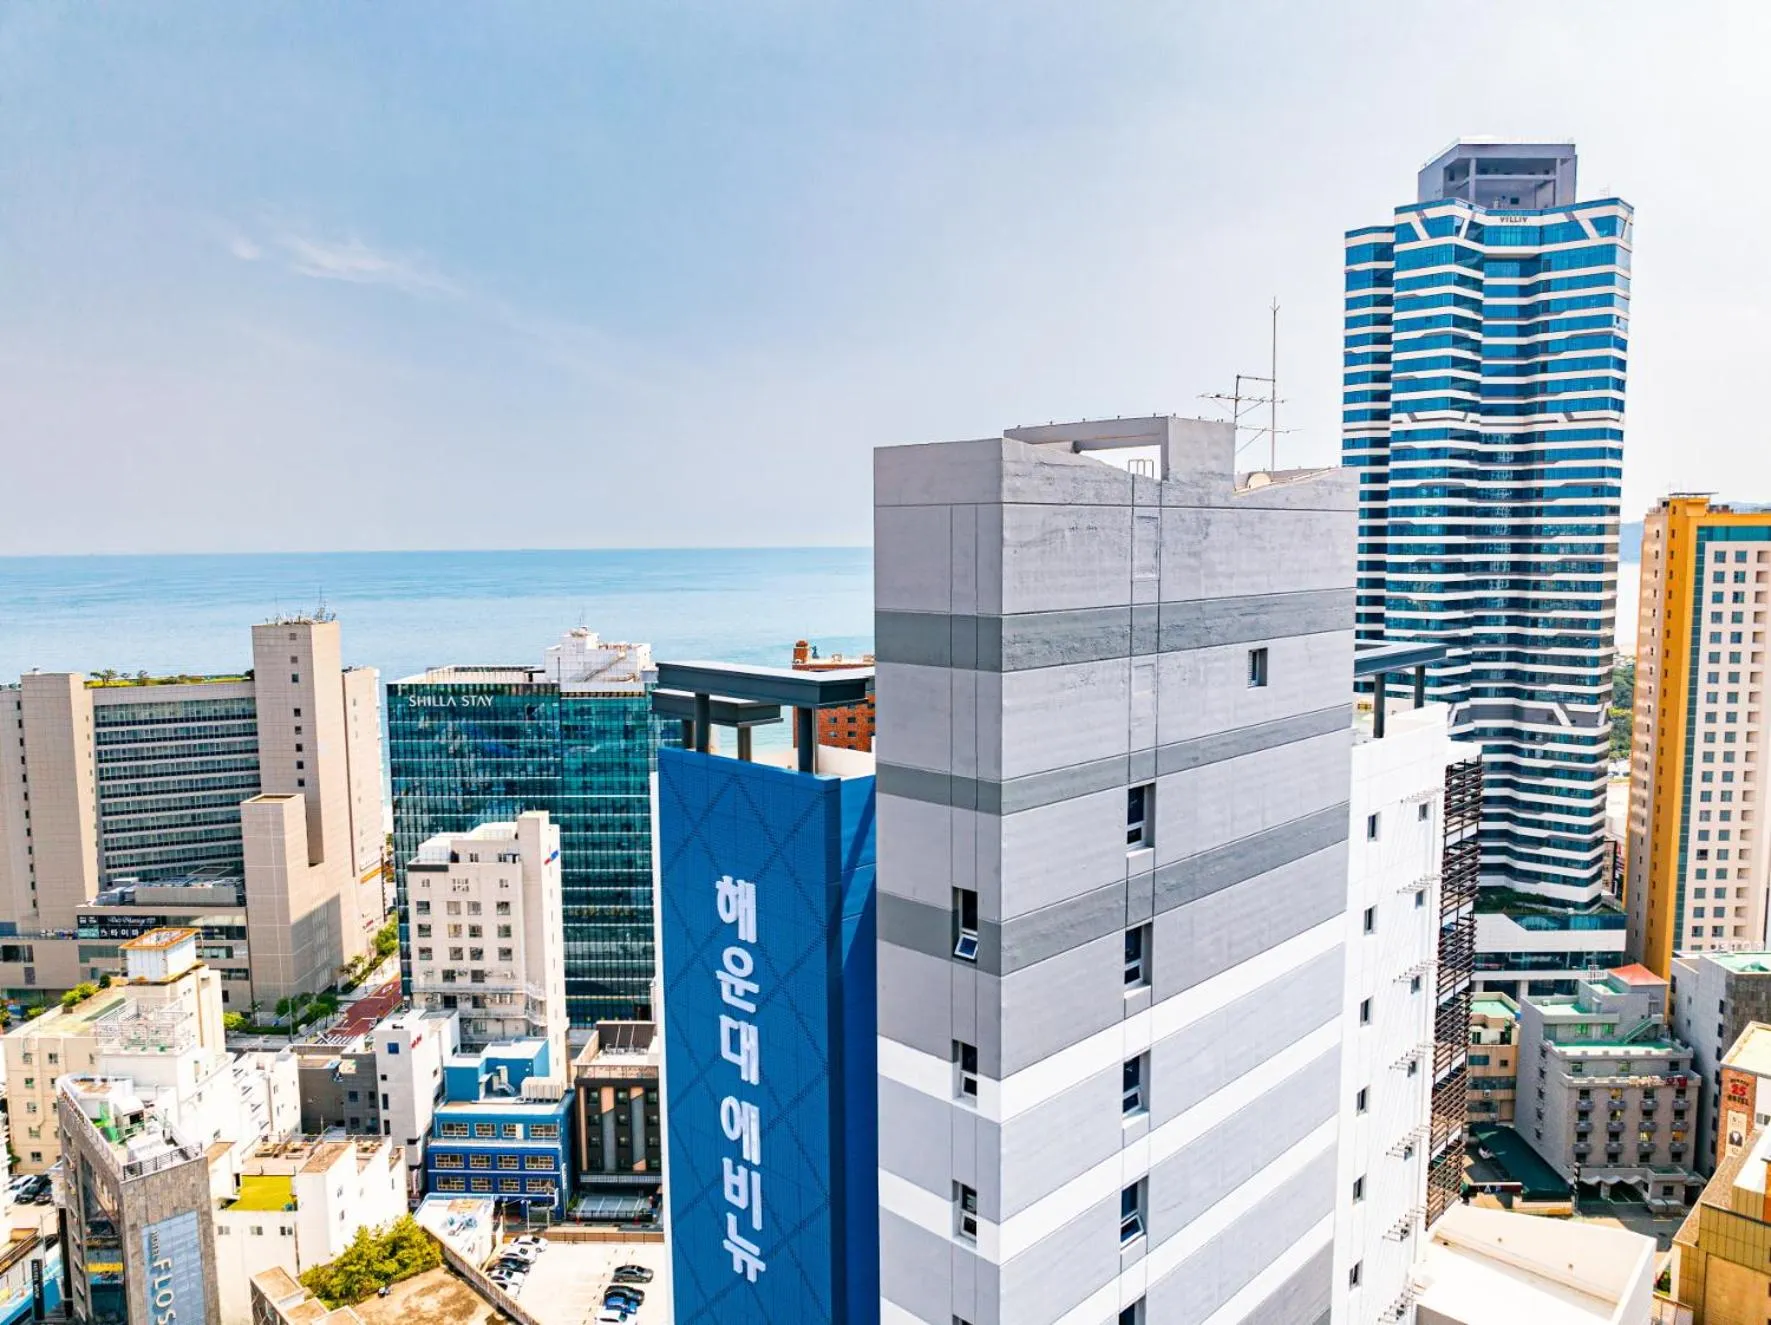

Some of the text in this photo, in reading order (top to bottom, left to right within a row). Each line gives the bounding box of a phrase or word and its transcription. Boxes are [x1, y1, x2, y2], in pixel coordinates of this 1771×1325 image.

[409, 695, 494, 707] SHILLA STAY
[716, 875, 766, 1283] 해운대 에비뉴
